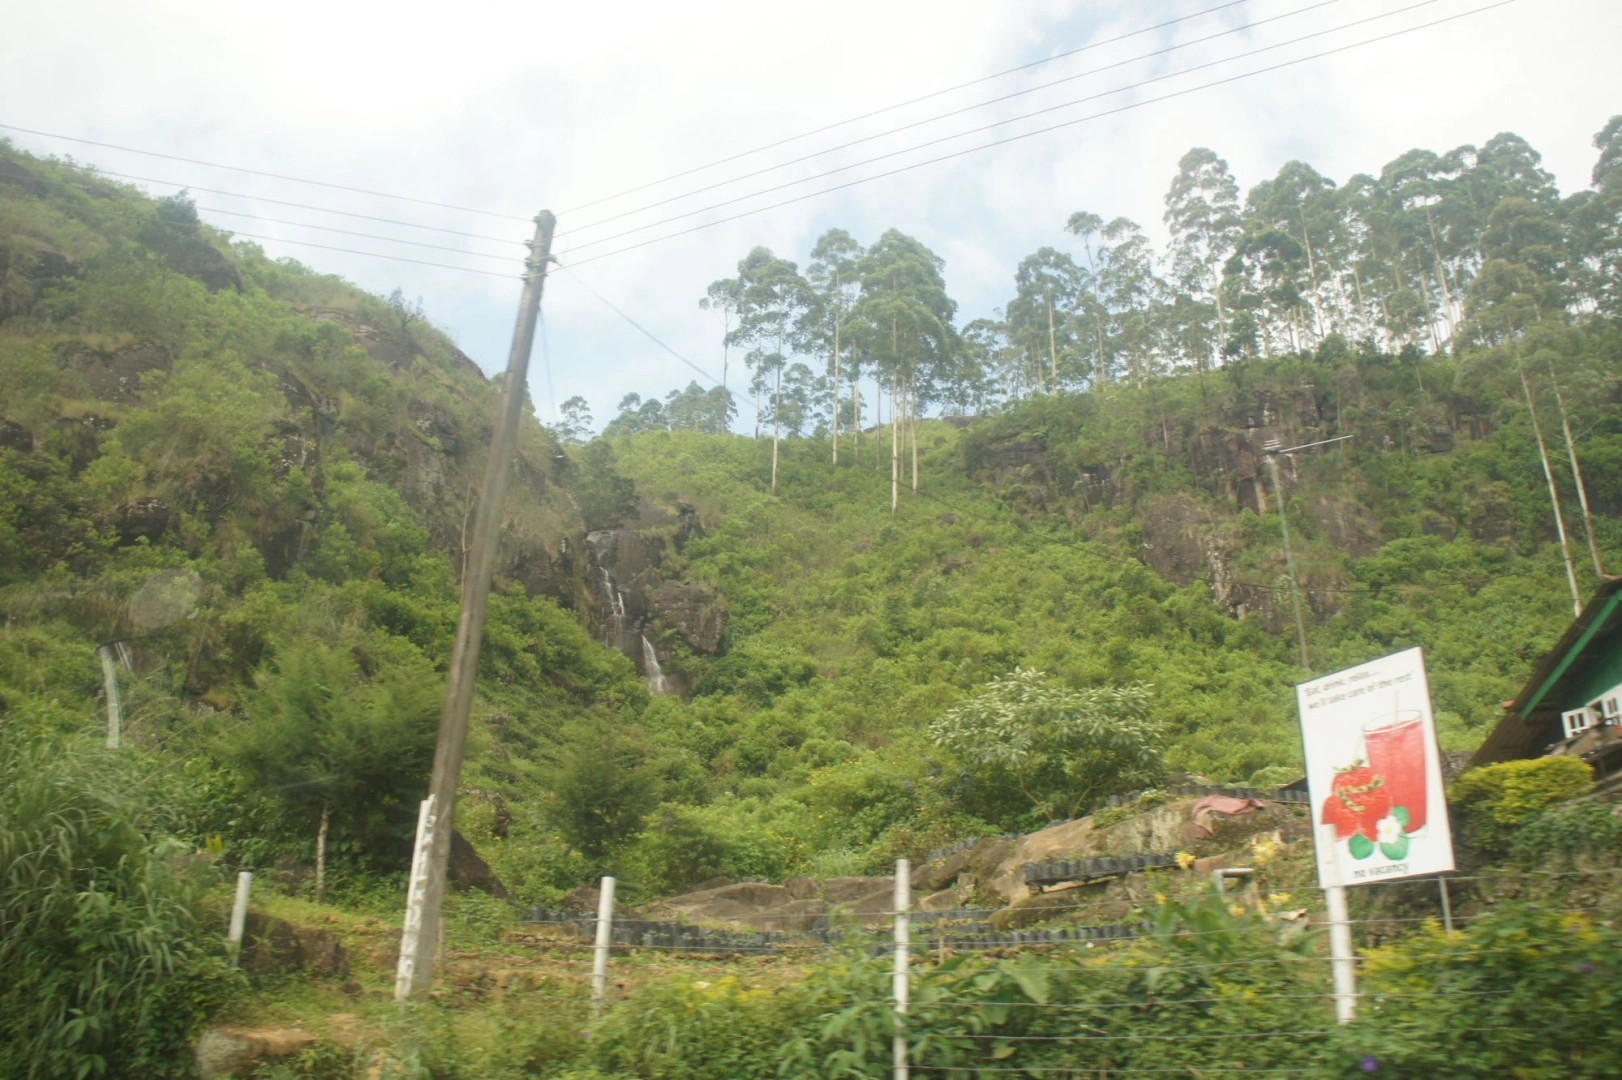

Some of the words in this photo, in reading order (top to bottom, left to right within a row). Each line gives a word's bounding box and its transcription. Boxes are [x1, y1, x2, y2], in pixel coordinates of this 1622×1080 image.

[1367, 682, 1377, 692] of
[1378, 678, 1392, 689] the
[1353, 869, 1366, 878] no
[1368, 863, 1408, 876] vacancy
